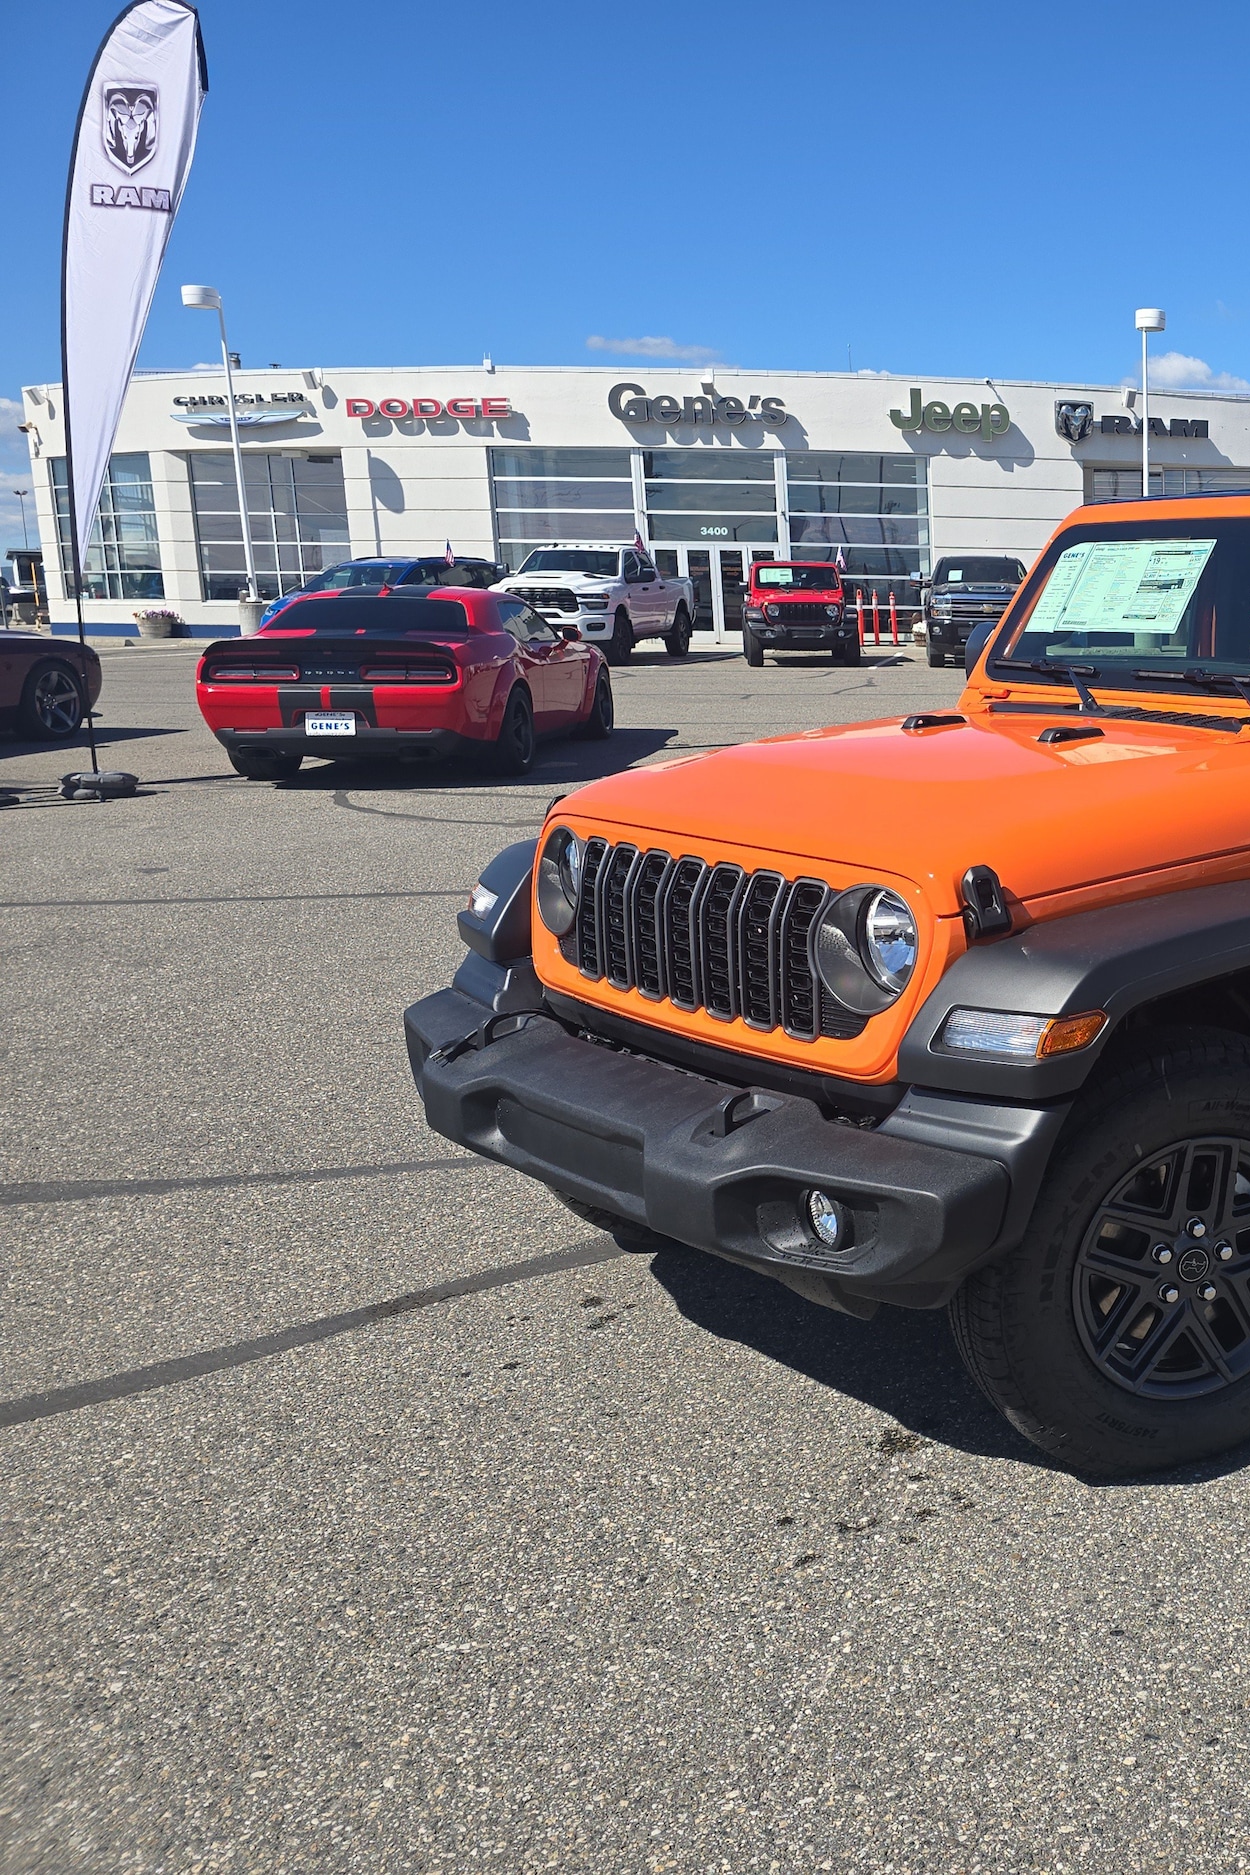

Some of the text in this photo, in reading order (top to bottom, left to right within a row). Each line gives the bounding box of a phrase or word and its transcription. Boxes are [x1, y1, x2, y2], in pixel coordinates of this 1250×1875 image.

[91, 184, 172, 212] RAM
[345, 397, 511, 418] DODGE
[608, 383, 787, 426] Gene's
[889, 388, 1010, 443] Jeep
[1101, 415, 1209, 439] RAM
[700, 526, 729, 536] 3400
[311, 722, 350, 730] GENE'S
